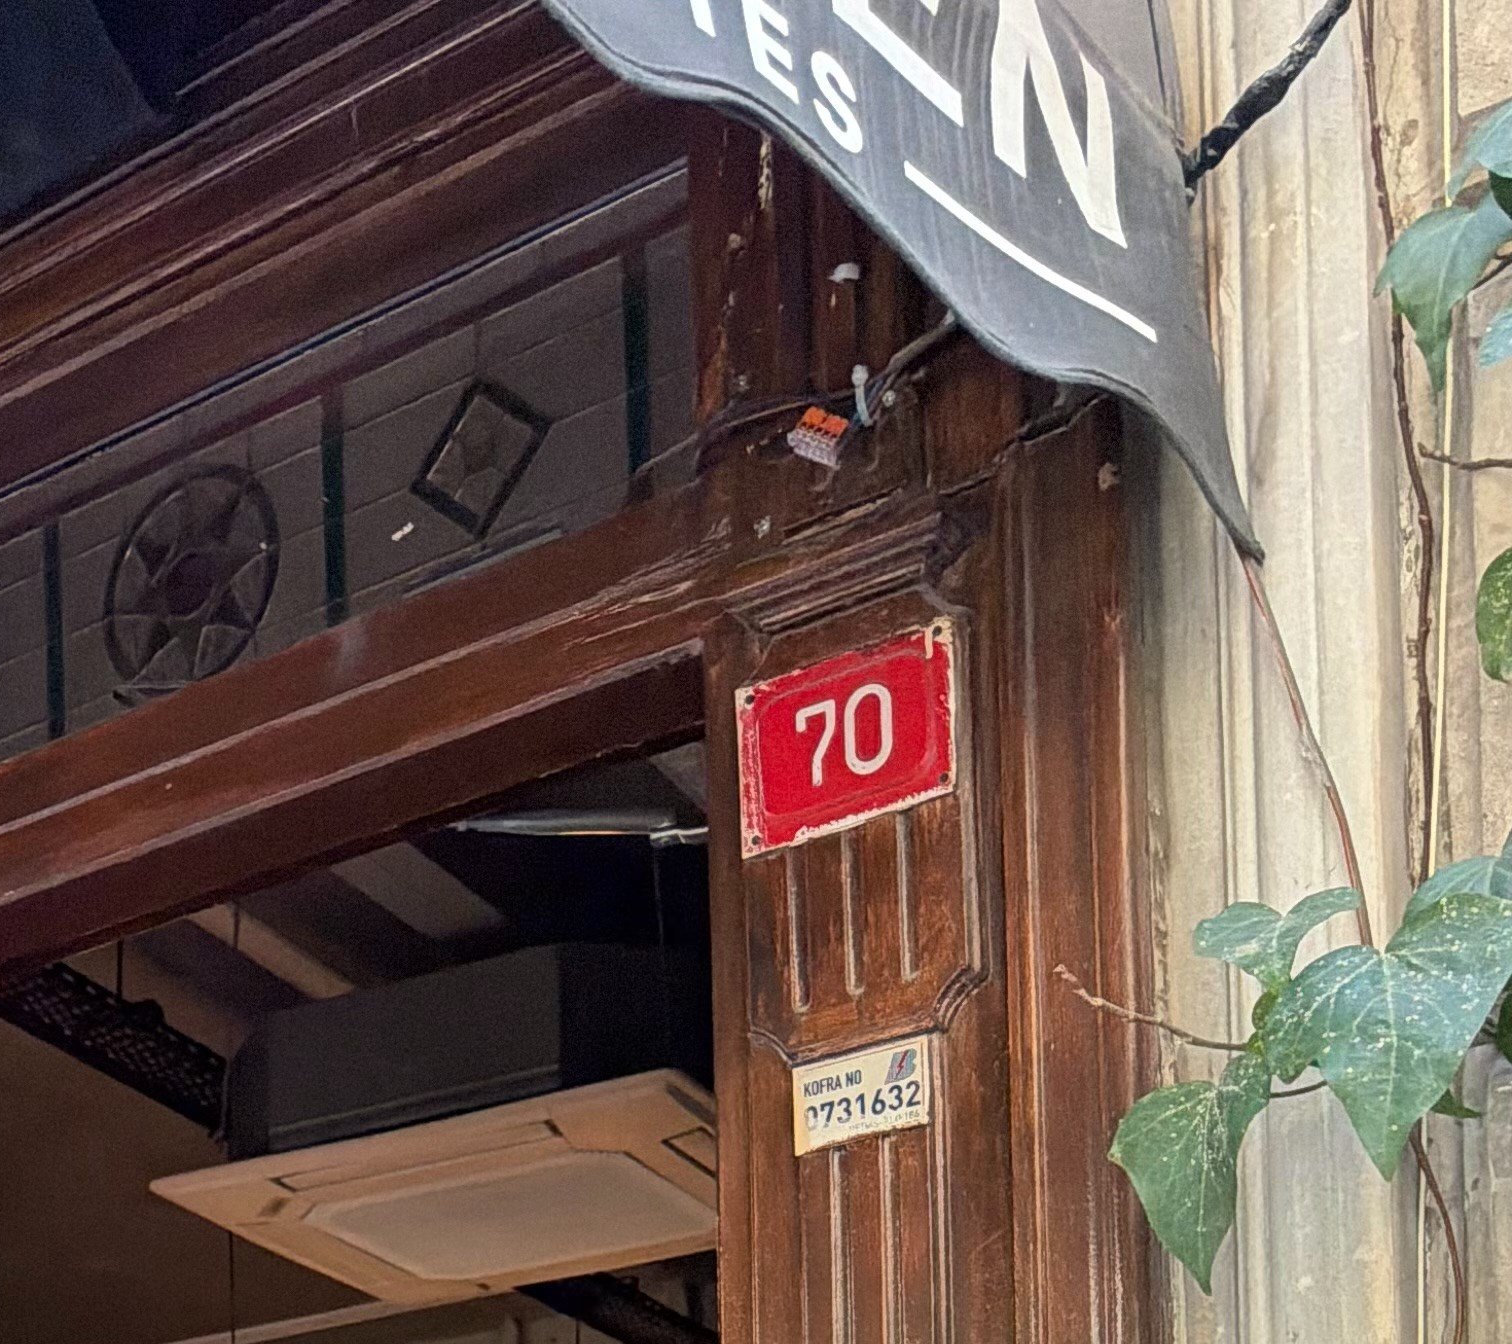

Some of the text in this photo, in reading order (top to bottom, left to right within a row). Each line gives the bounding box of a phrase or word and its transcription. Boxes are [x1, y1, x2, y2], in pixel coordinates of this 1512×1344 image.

[795, 683, 893, 787] 70
[803, 1069, 862, 1097] KOFRA NO
